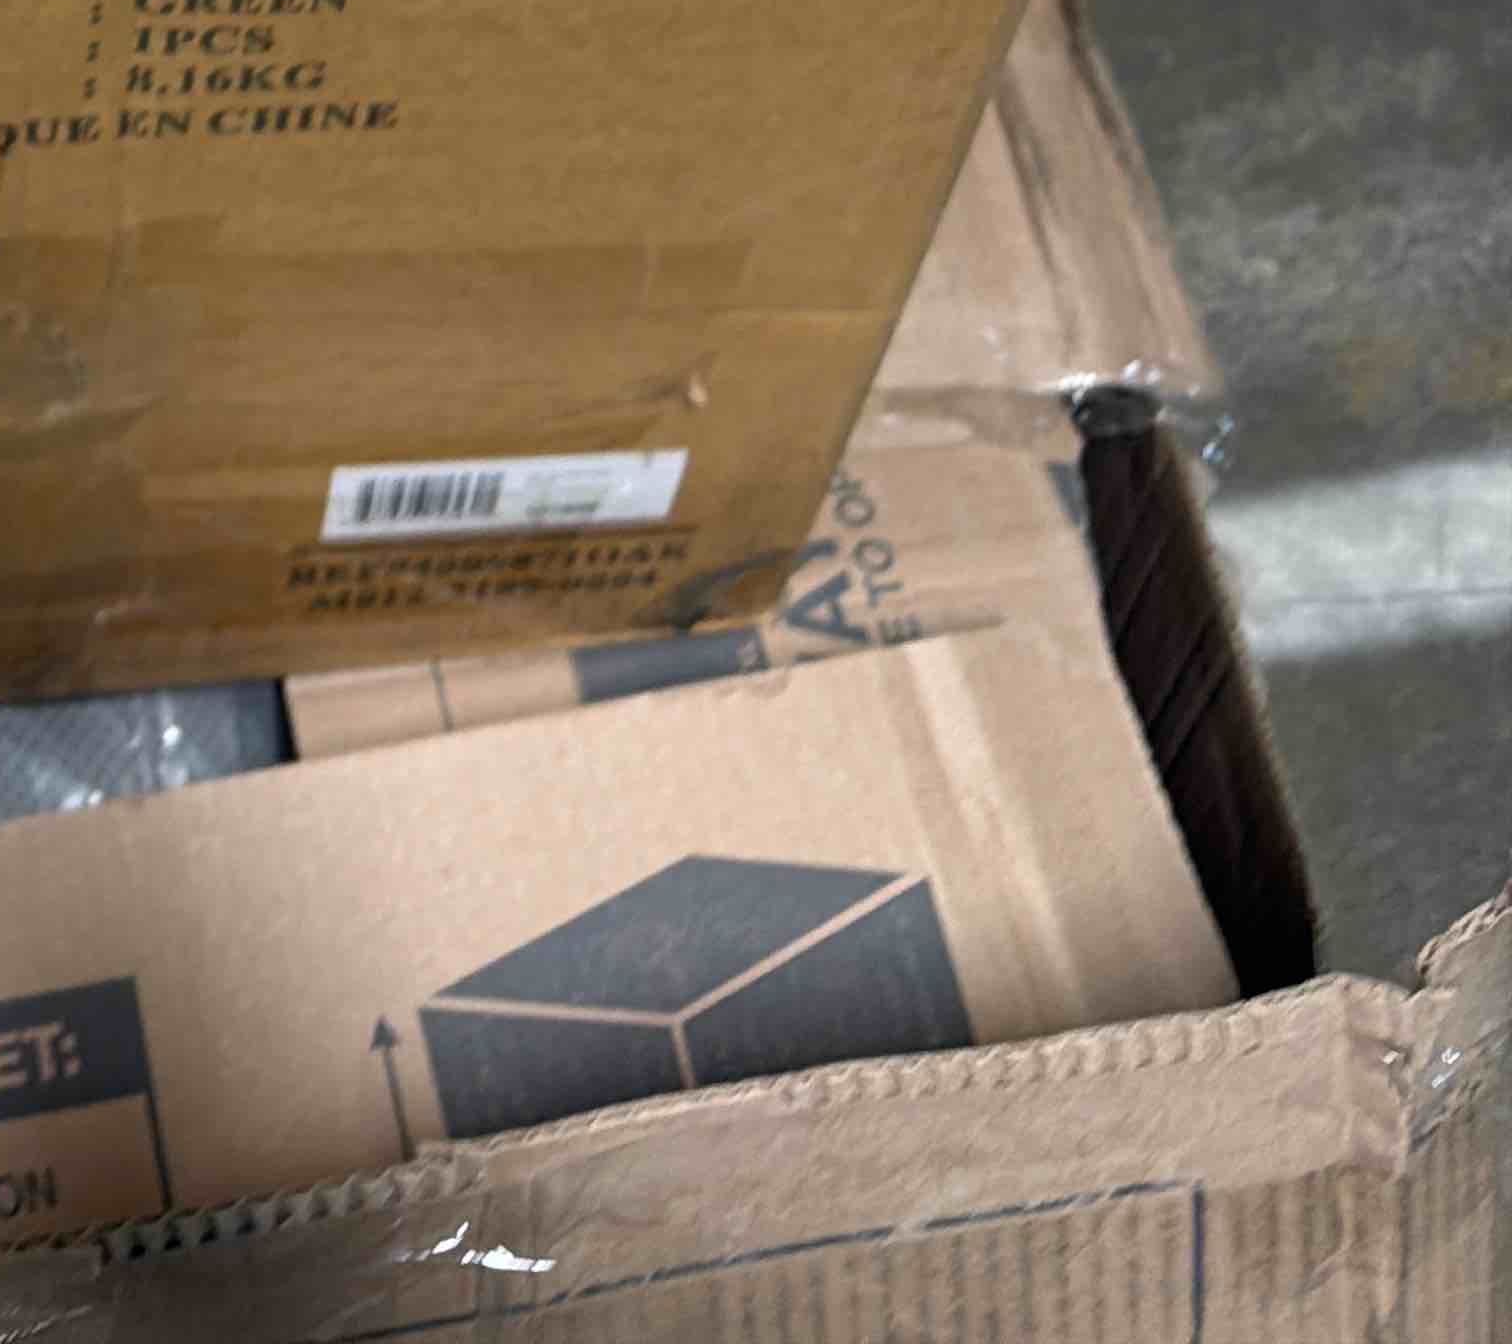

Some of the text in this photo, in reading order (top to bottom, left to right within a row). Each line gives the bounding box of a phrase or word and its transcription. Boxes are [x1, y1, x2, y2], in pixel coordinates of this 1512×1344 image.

[135, 24, 277, 56] 1PCS
[115, 108, 192, 142] EN
[205, 99, 401, 138] CHINE
